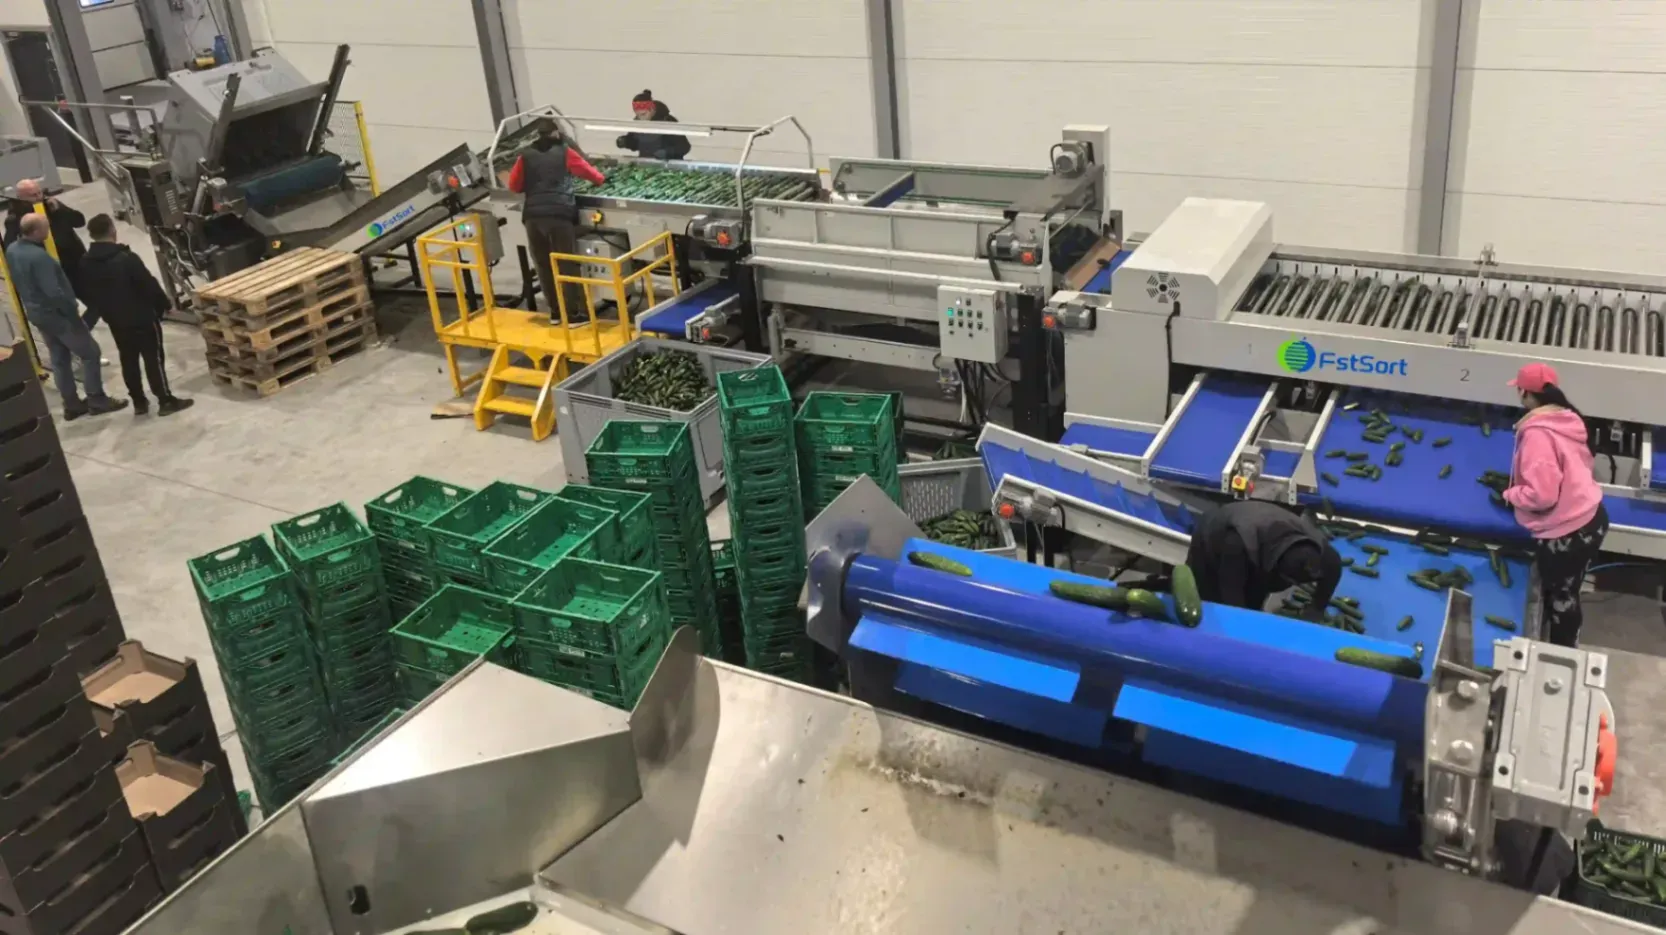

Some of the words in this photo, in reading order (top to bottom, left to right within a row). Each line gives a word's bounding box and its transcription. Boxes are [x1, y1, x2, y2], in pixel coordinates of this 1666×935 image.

[382, 205, 415, 229] FstSort
[1318, 352, 1408, 376] FstSort
[1460, 368, 1470, 382] 2
